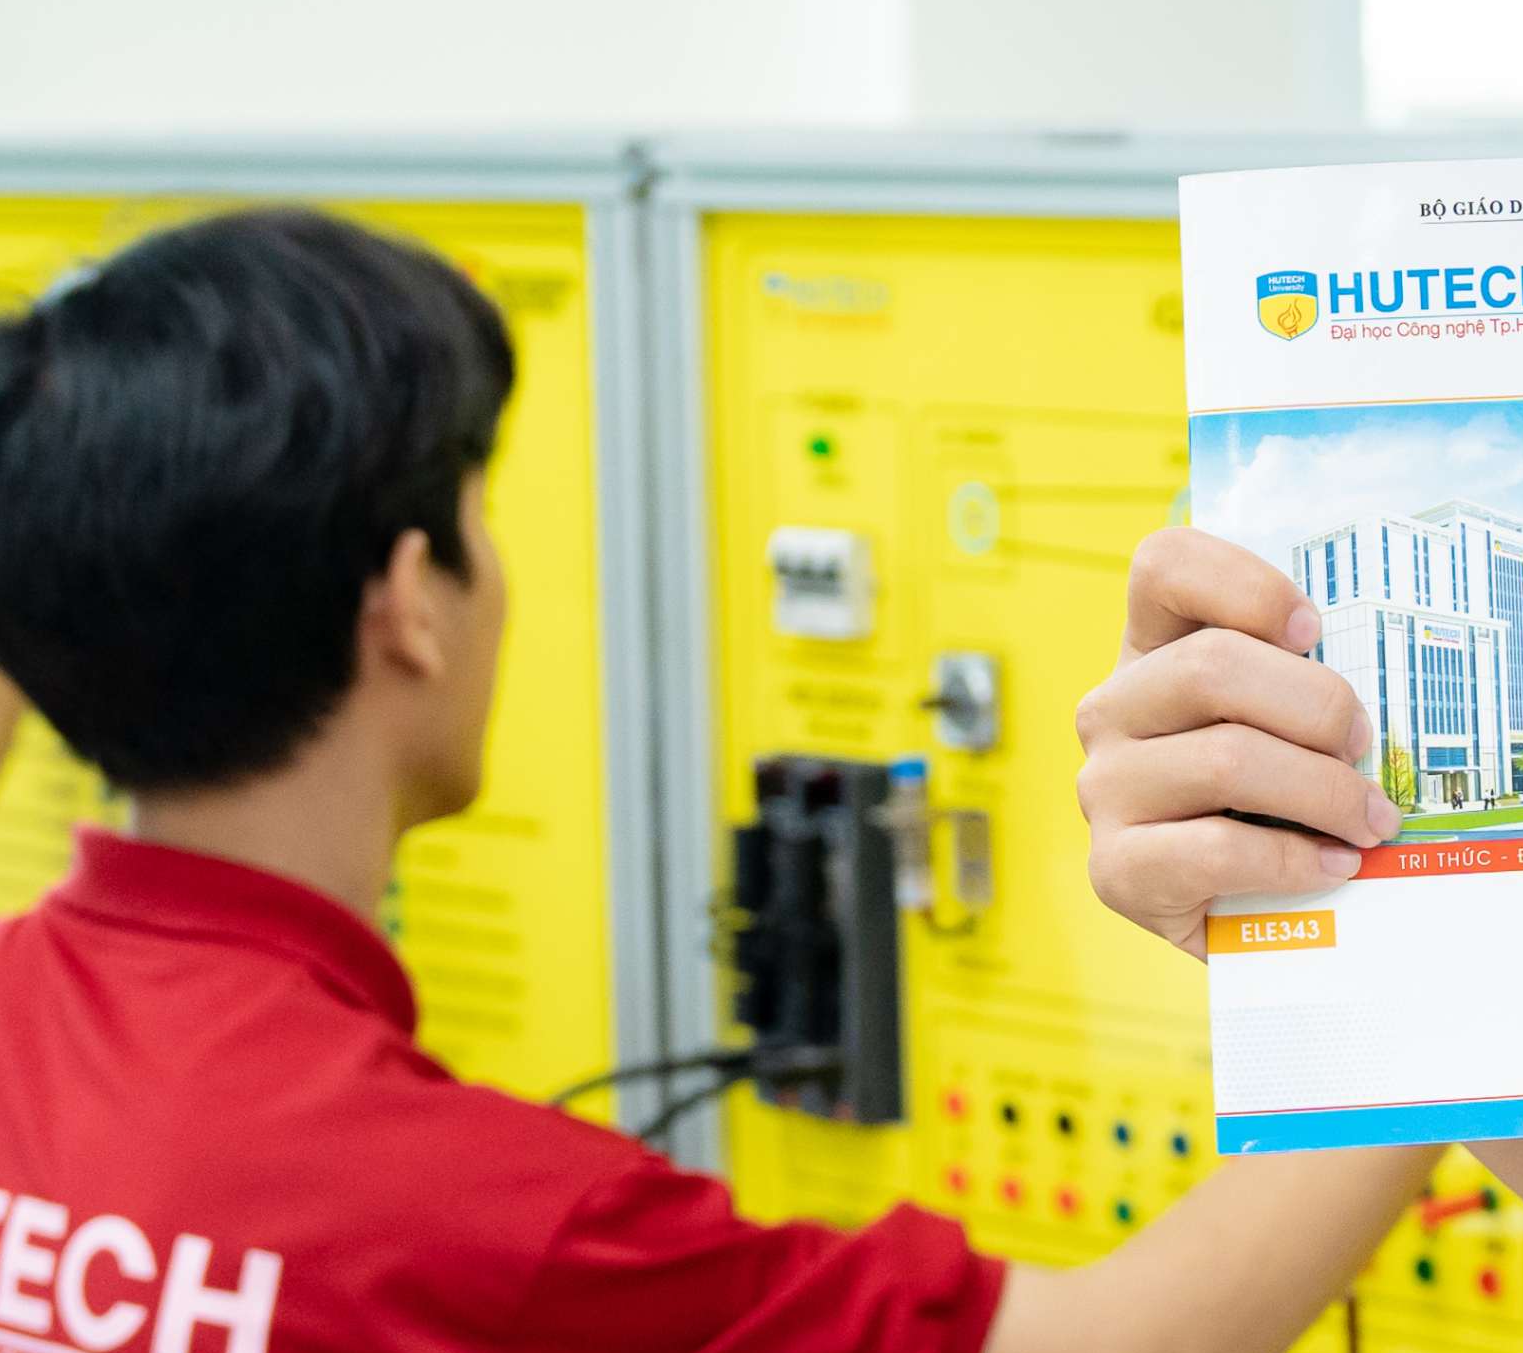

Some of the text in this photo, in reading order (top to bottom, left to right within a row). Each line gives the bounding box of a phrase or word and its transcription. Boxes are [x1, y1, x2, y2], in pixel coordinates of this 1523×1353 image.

[1420, 198, 1447, 220] BỘ
[1453, 197, 1504, 216] GIÁO
[1331, 324, 1358, 342] Đại
[1362, 323, 1392, 341] học
[1397, 319, 1441, 339] Công
[1446, 318, 1485, 338] nghệ
[1399, 853, 1428, 871] TRI
[1437, 847, 1491, 867] THỨC
[1241, 920, 1320, 943] ELE343
